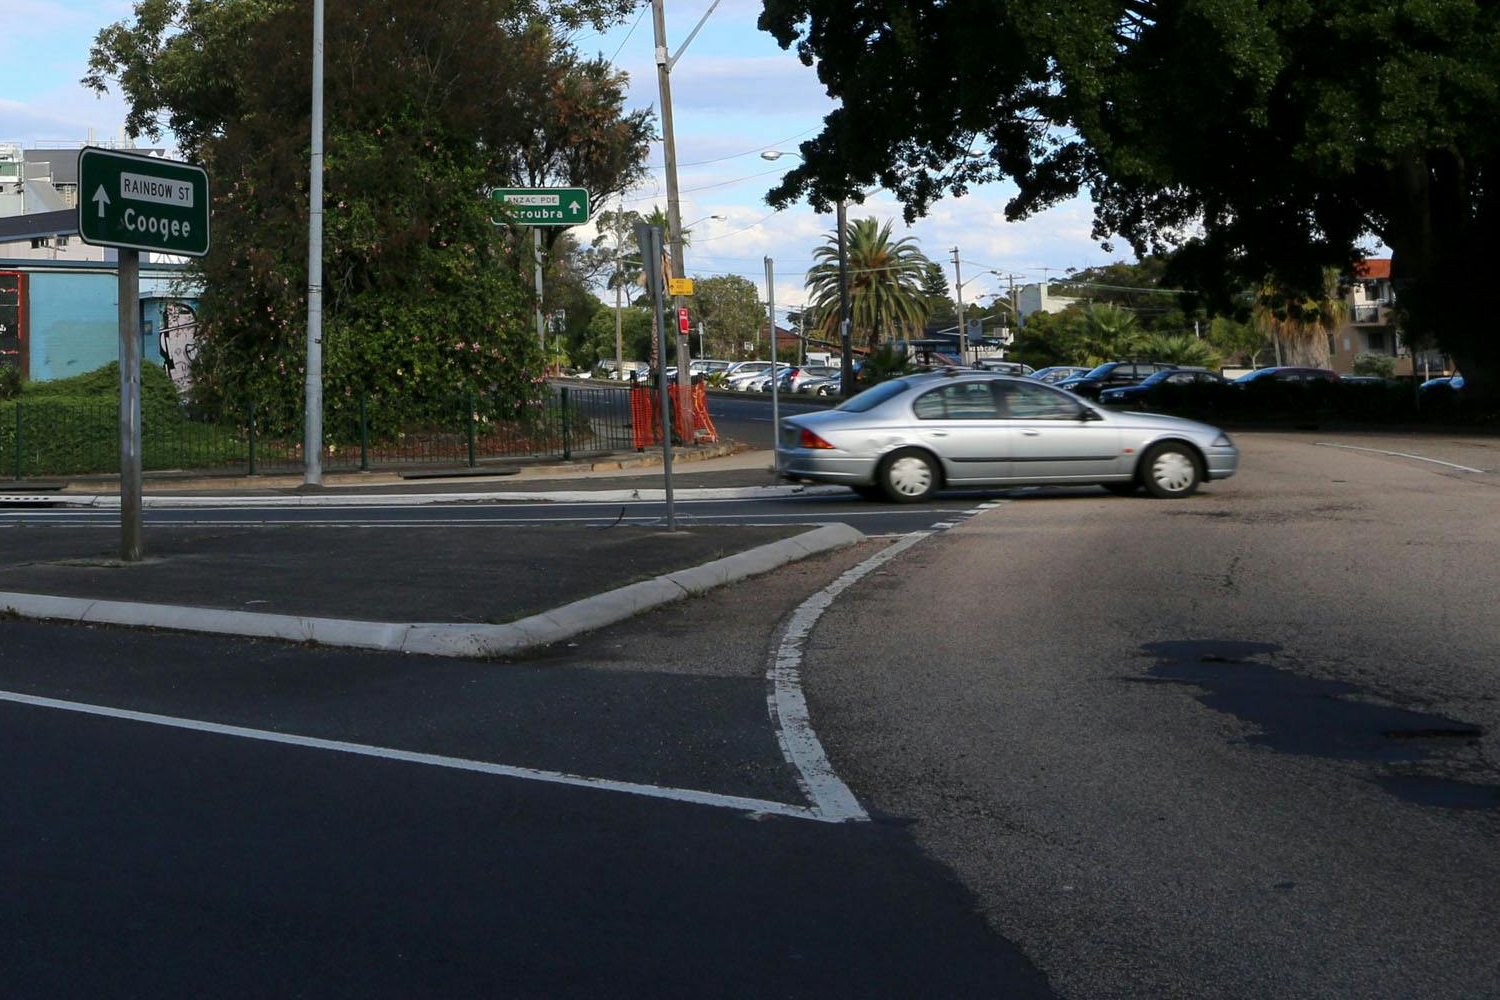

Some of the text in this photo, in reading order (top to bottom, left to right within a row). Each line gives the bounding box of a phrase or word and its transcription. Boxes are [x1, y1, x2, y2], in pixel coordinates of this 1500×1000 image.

[124, 178, 190, 201] RAINBOW ST
[507, 196, 558, 204] ANZAC PDE
[124, 208, 191, 242] Coogee
